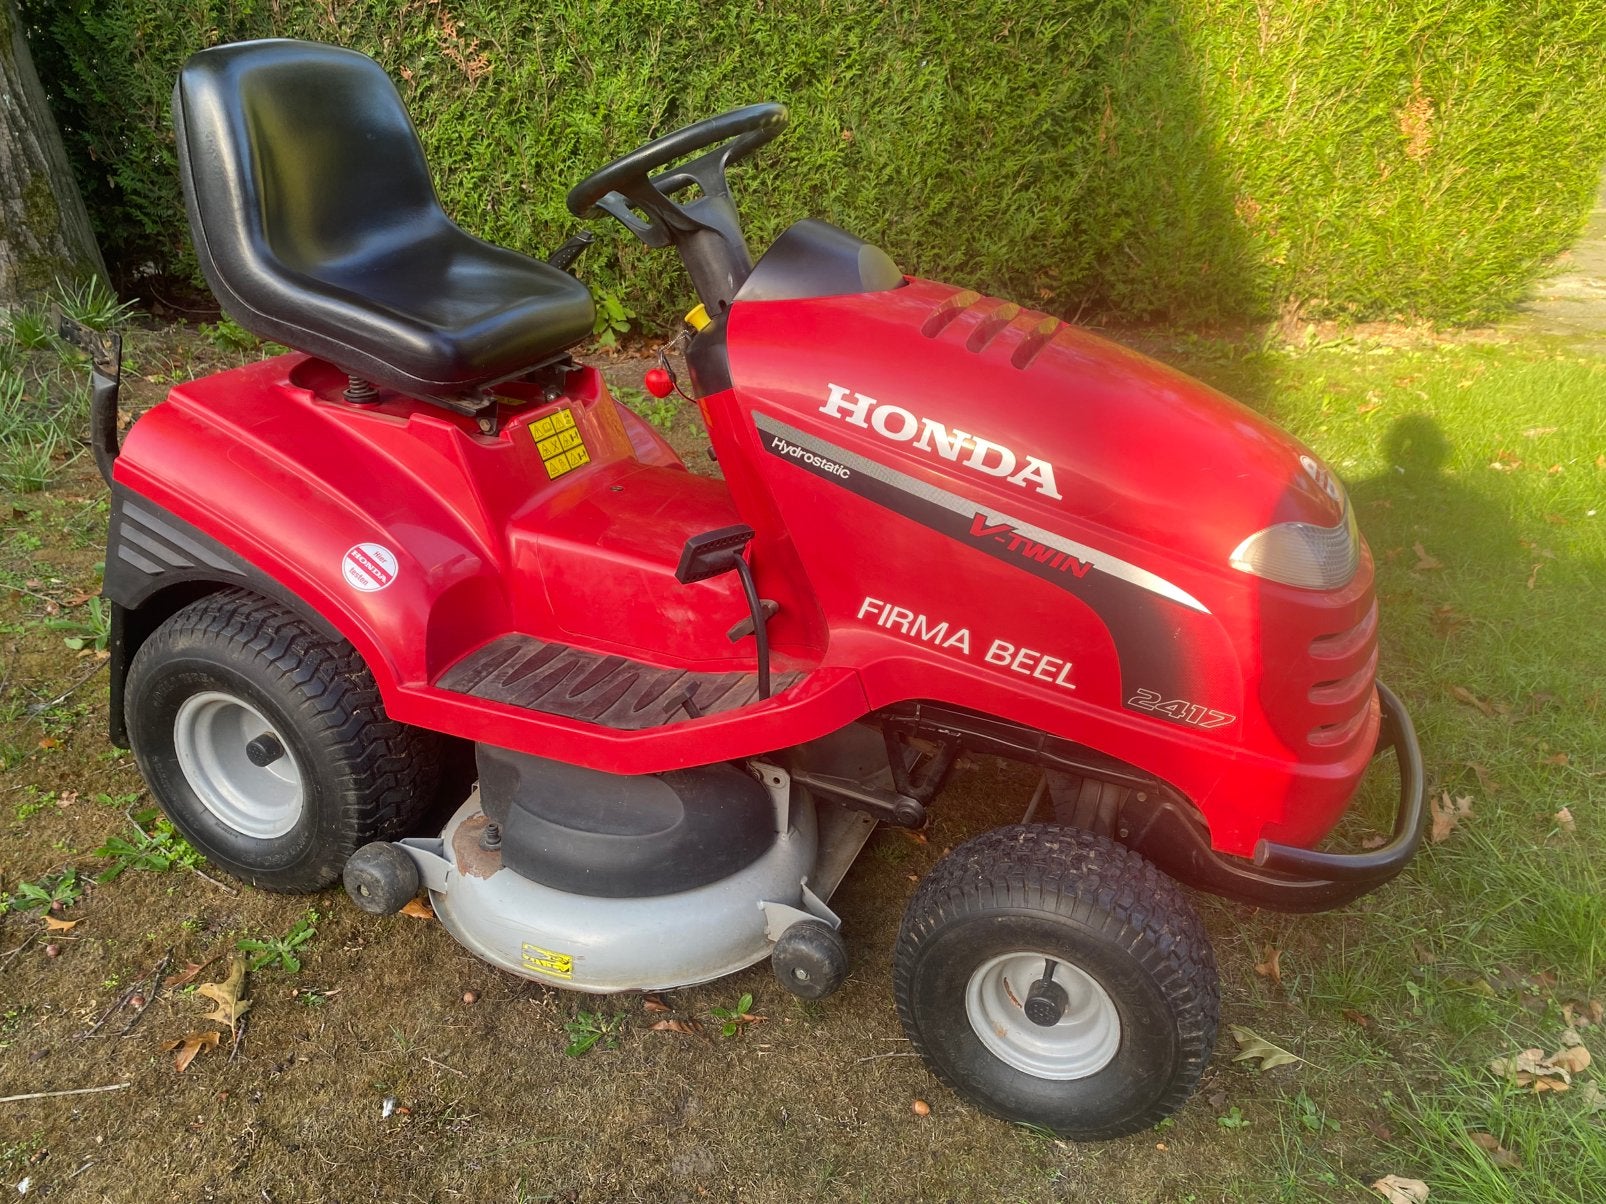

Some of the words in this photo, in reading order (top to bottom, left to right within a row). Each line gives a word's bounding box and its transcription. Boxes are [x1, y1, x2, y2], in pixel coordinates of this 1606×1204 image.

[771, 436, 850, 478] Hydrostatic
[819, 383, 1062, 501] HONDA
[373, 550, 388, 563] Hier
[969, 512, 1095, 578] V-TWIN
[351, 550, 387, 584] HONDA
[857, 596, 970, 655] FIRMA
[984, 639, 1077, 689] BEEL
[1127, 687, 1237, 729] 2417
